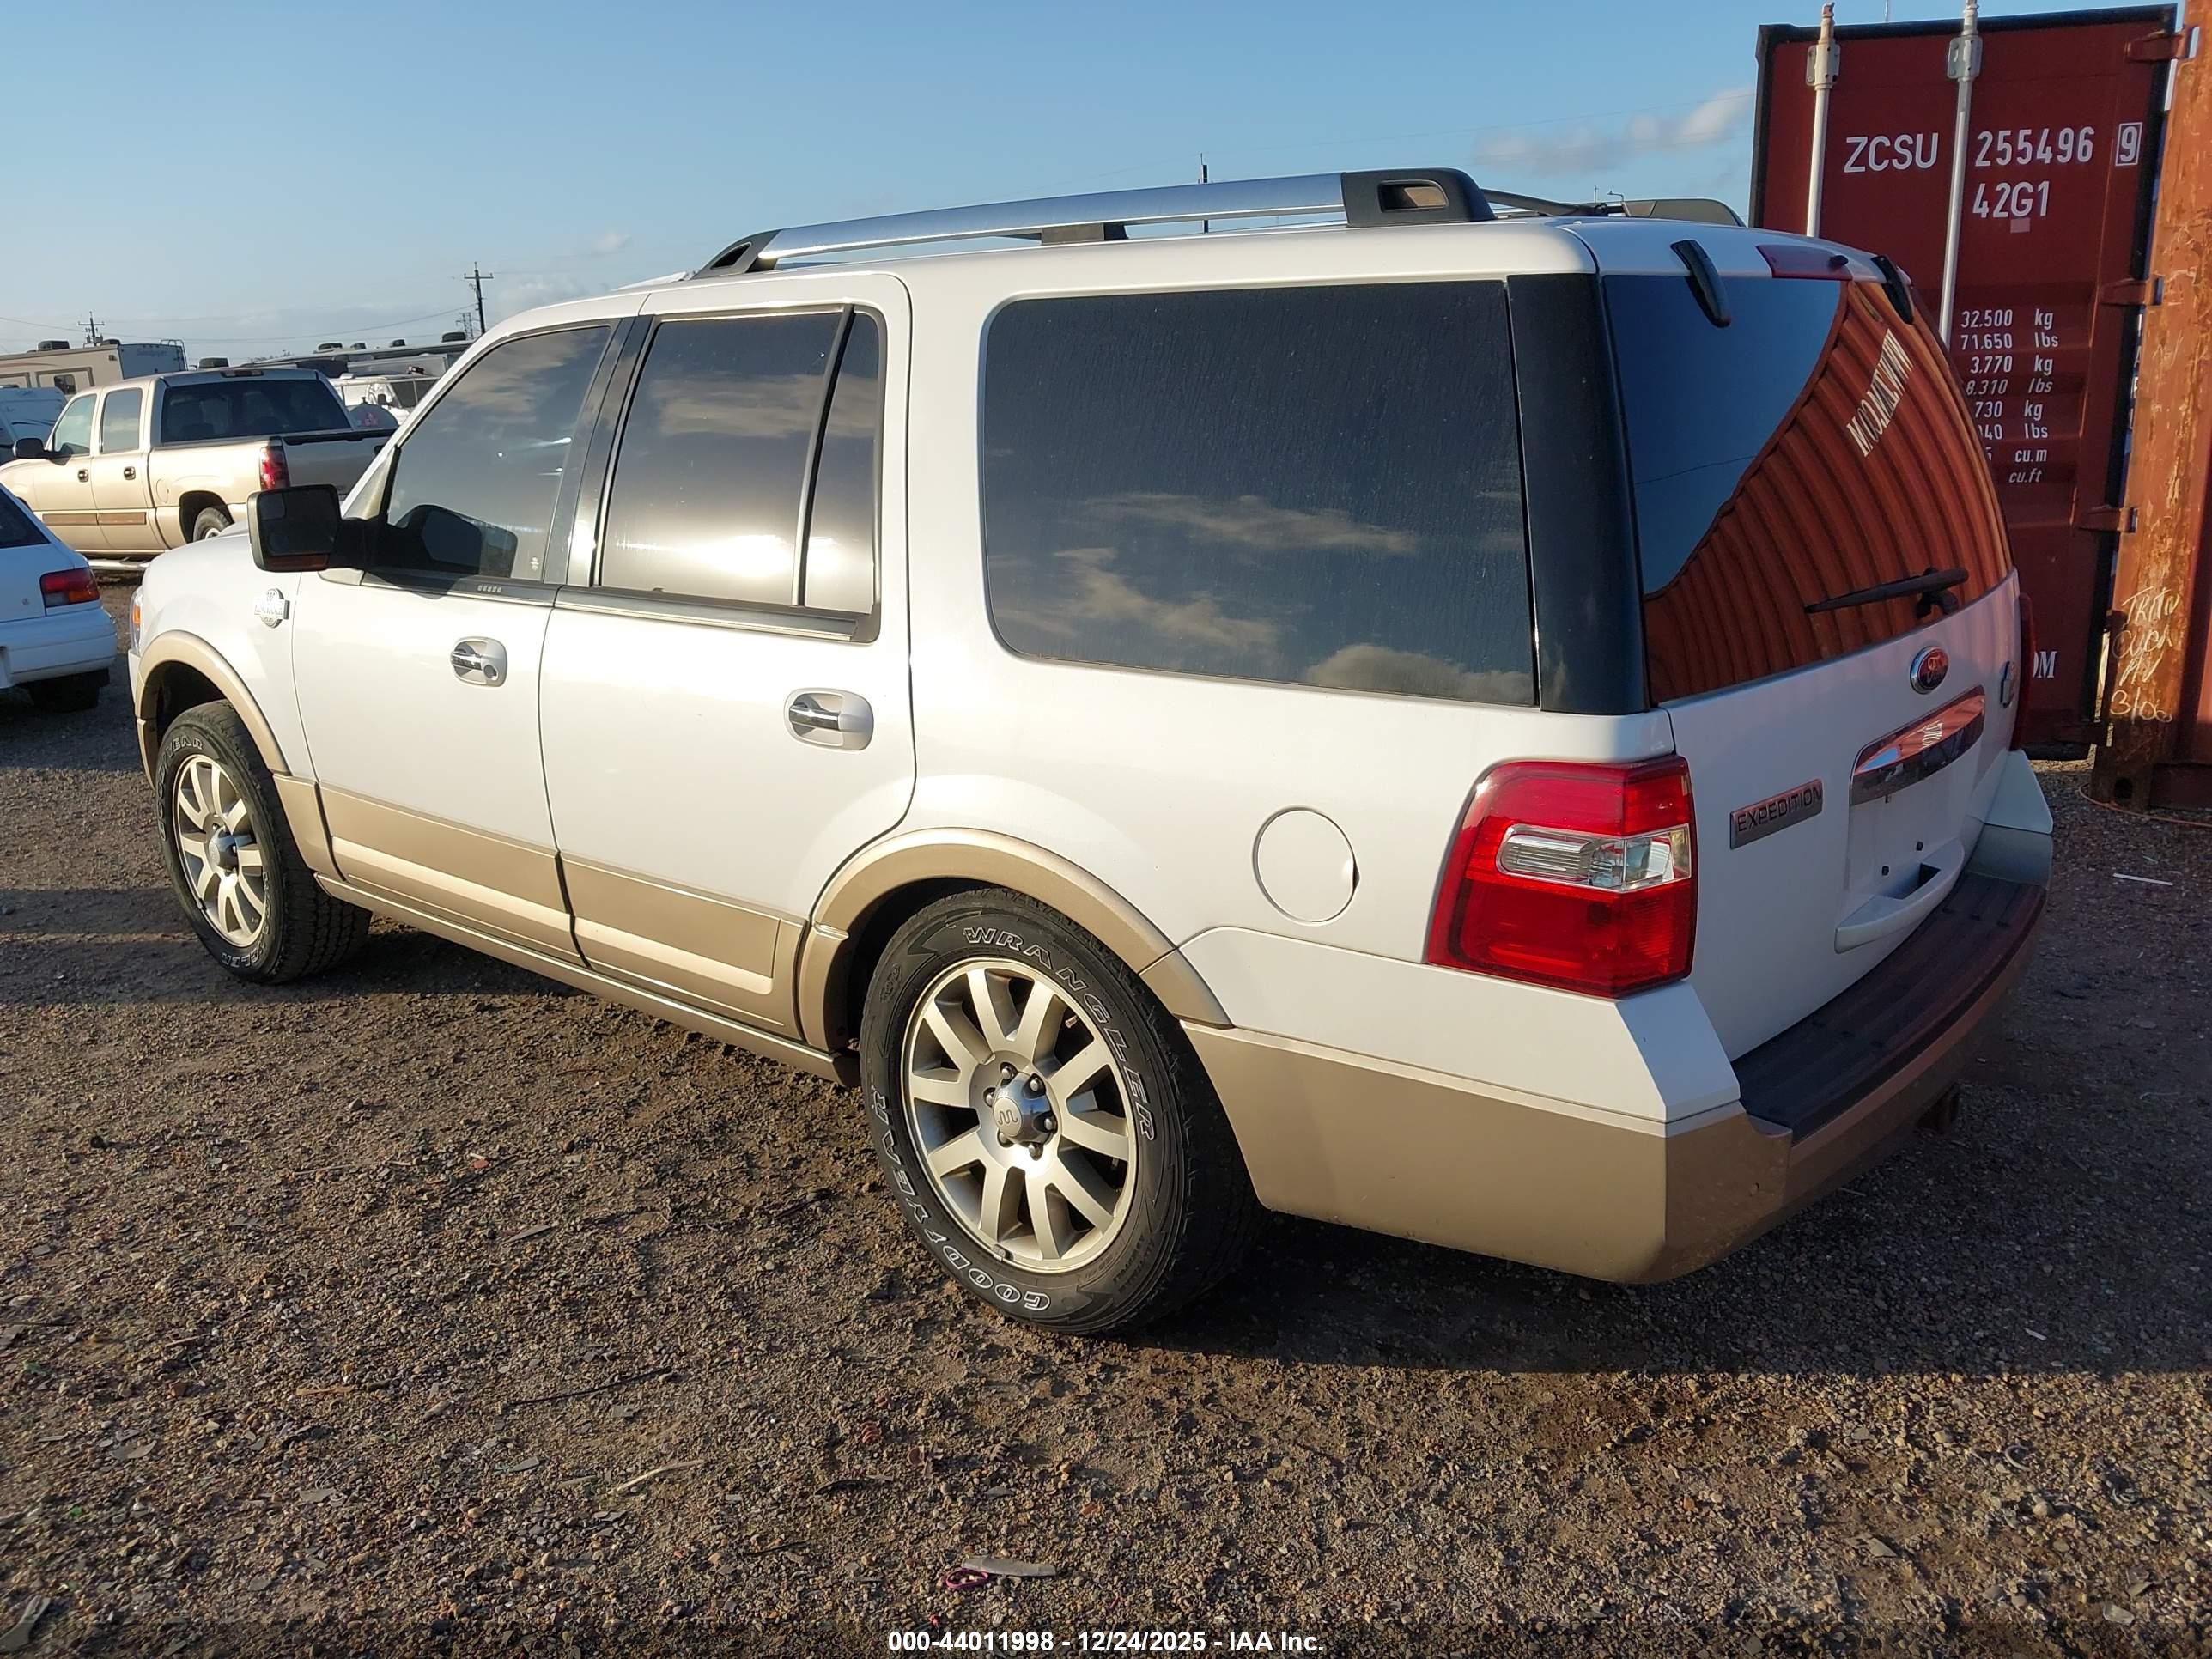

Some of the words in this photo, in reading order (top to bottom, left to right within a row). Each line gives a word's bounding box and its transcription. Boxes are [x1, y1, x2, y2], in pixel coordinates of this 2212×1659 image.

[1844, 132, 1938, 173] ZCSU
[1975, 126, 2094, 167] 255496
[2119, 125, 2138, 162] 9
[1972, 180, 2050, 218] 42G1
[1960, 309, 2013, 328] 32.500
[2034, 308, 2053, 330] kg
[1960, 333, 2013, 350] 71.650
[2034, 331, 2059, 348] lbs
[1970, 355, 2013, 374] 3.770
[2034, 354, 2053, 376] kg
[1966, 379, 2008, 395] 8.310
[2027, 378, 2053, 393] lbs
[2024, 400, 2043, 421] kg
[2024, 422, 2048, 439] lbs
[2014, 449, 2047, 463] cu.m
[2008, 468, 2042, 483] cu.ft
[1737, 787, 1822, 832] EXPEDITION
[963, 927, 1155, 1141] WRANGLER
[874, 1091, 1050, 1310] GOODYEAR
